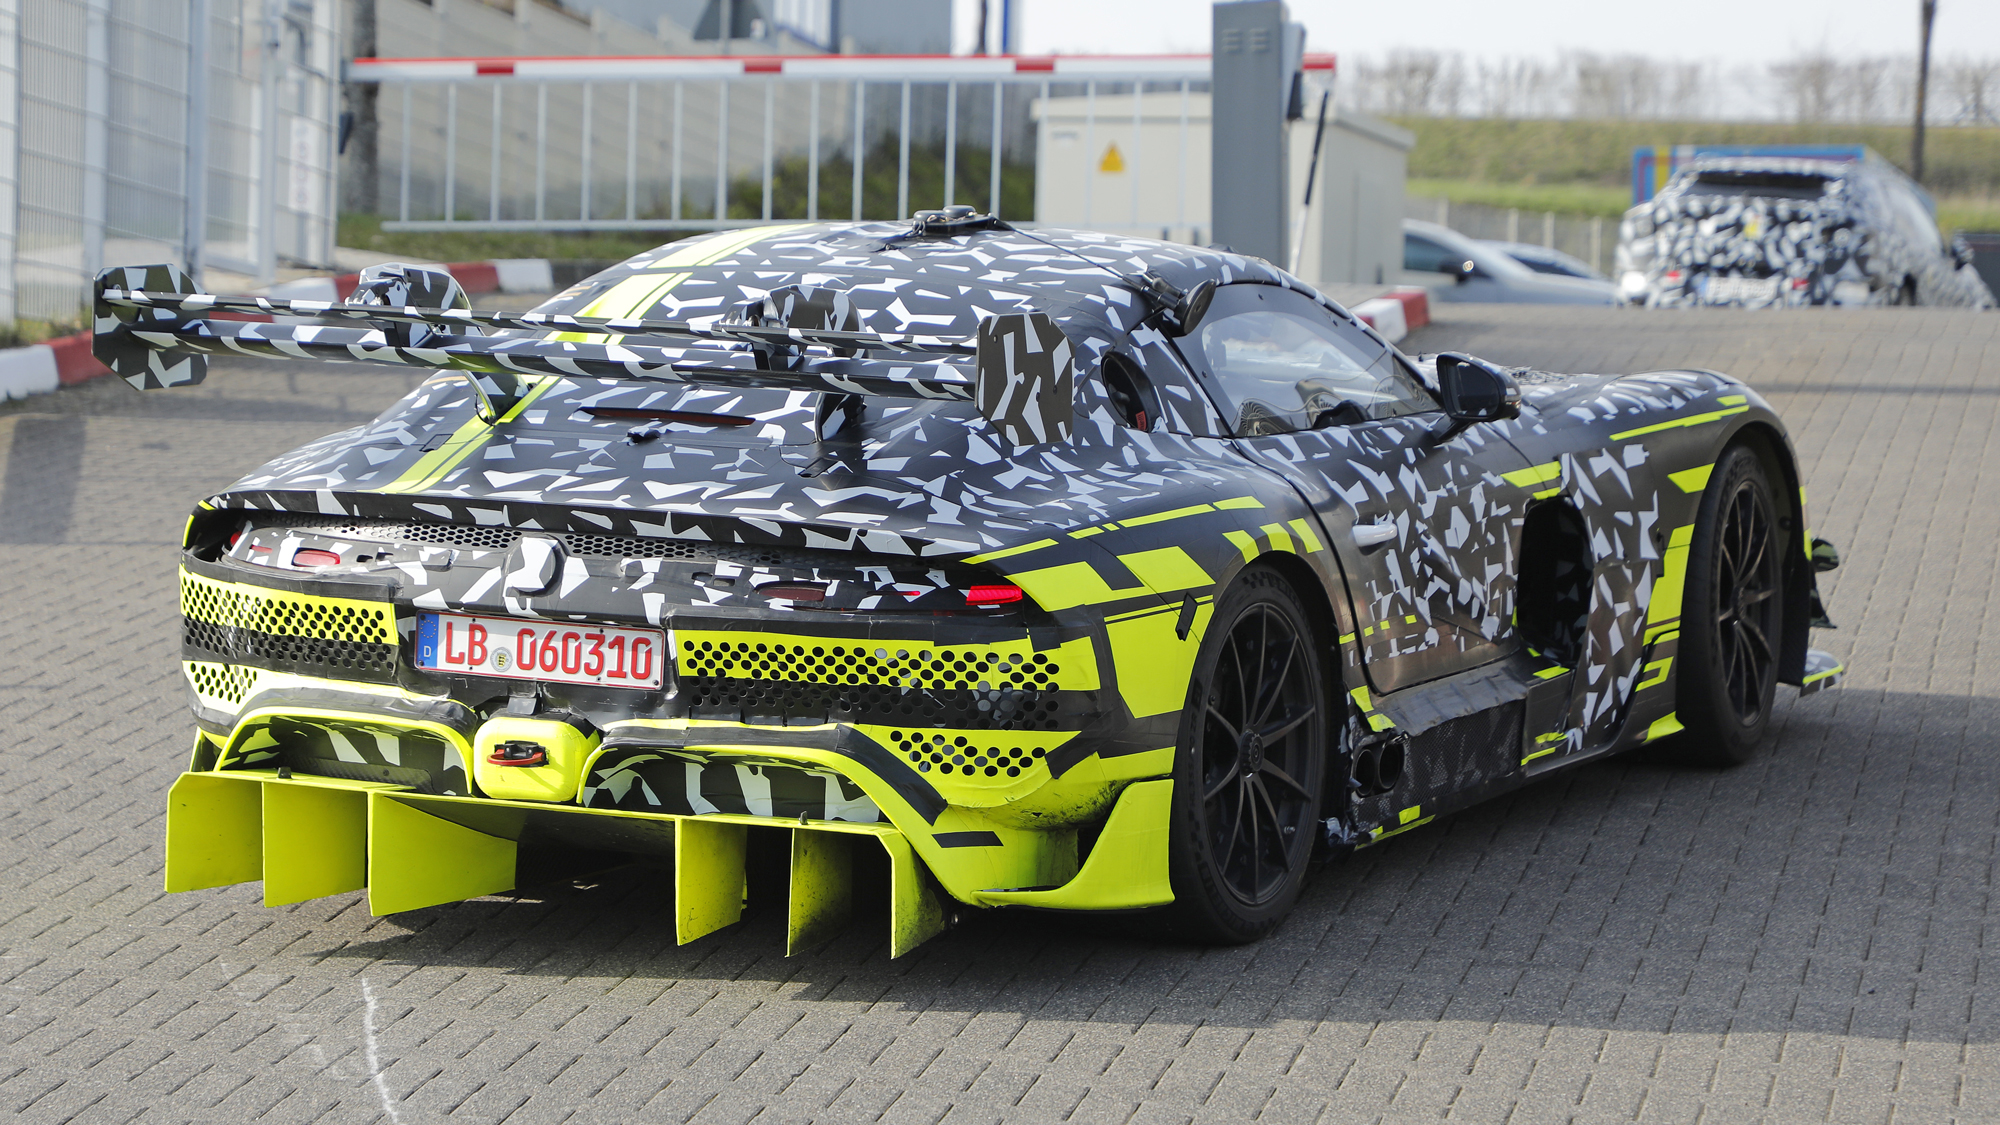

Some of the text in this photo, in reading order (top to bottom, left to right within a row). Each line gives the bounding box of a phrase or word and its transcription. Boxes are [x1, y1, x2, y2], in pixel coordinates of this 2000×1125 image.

[423, 645, 432, 658] D
[445, 621, 488, 666] LB
[516, 628, 653, 679] 060310
